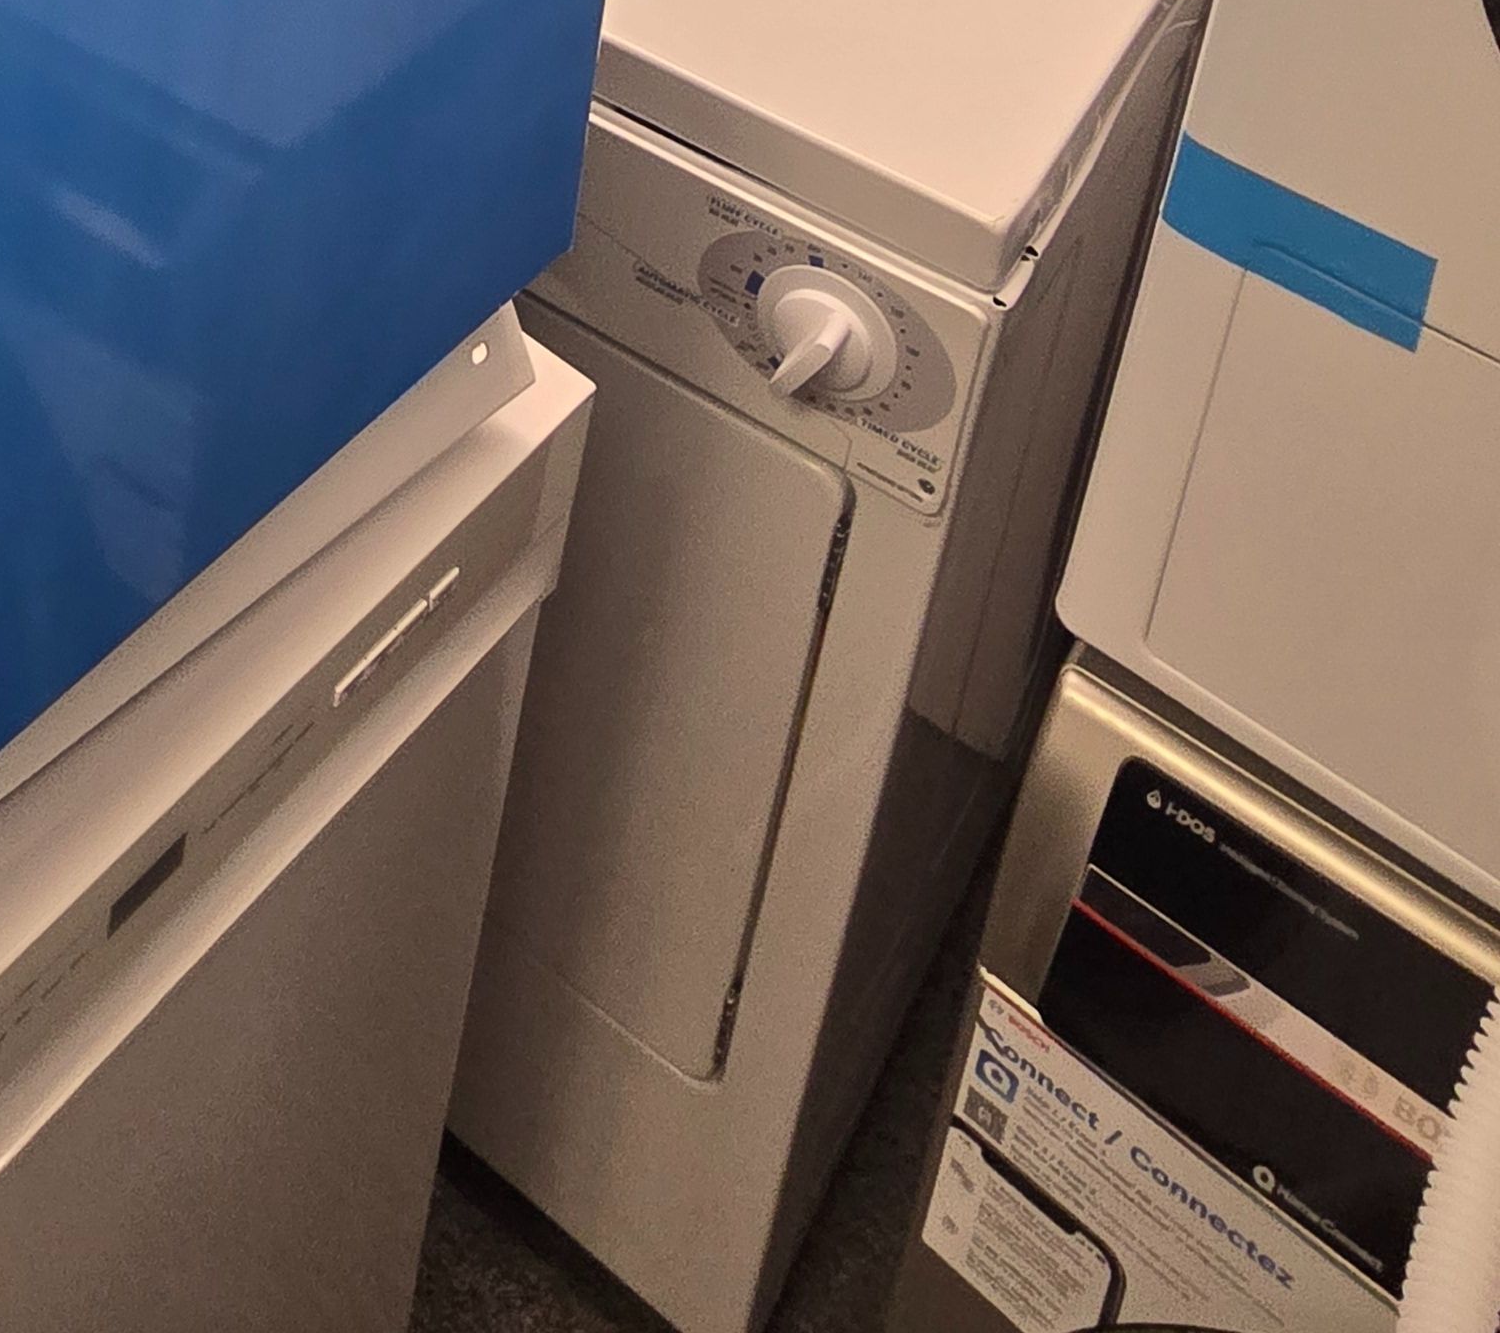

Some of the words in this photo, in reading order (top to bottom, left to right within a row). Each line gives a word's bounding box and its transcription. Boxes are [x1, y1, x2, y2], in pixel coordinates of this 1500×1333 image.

[860, 417, 899, 444] TIMED
[901, 439, 940, 467] CYCLE
[1393, 1095, 1455, 1144] BO
[1129, 1145, 1294, 1283] Connectez
